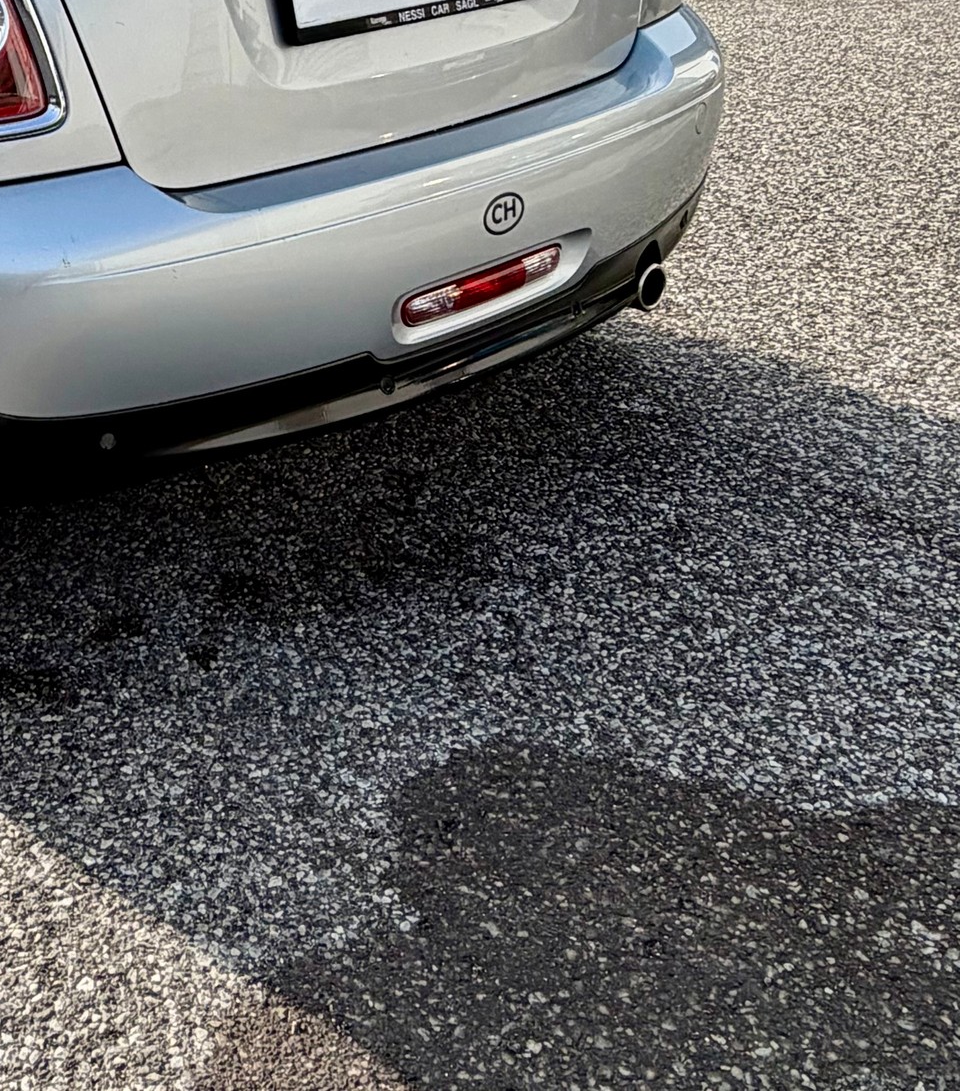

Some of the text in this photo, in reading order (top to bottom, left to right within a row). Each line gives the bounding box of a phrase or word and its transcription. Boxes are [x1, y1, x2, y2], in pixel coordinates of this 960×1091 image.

[398, 8, 426, 23] NESSI
[431, 3, 450, 17] CAR
[492, 198, 516, 225] CH
